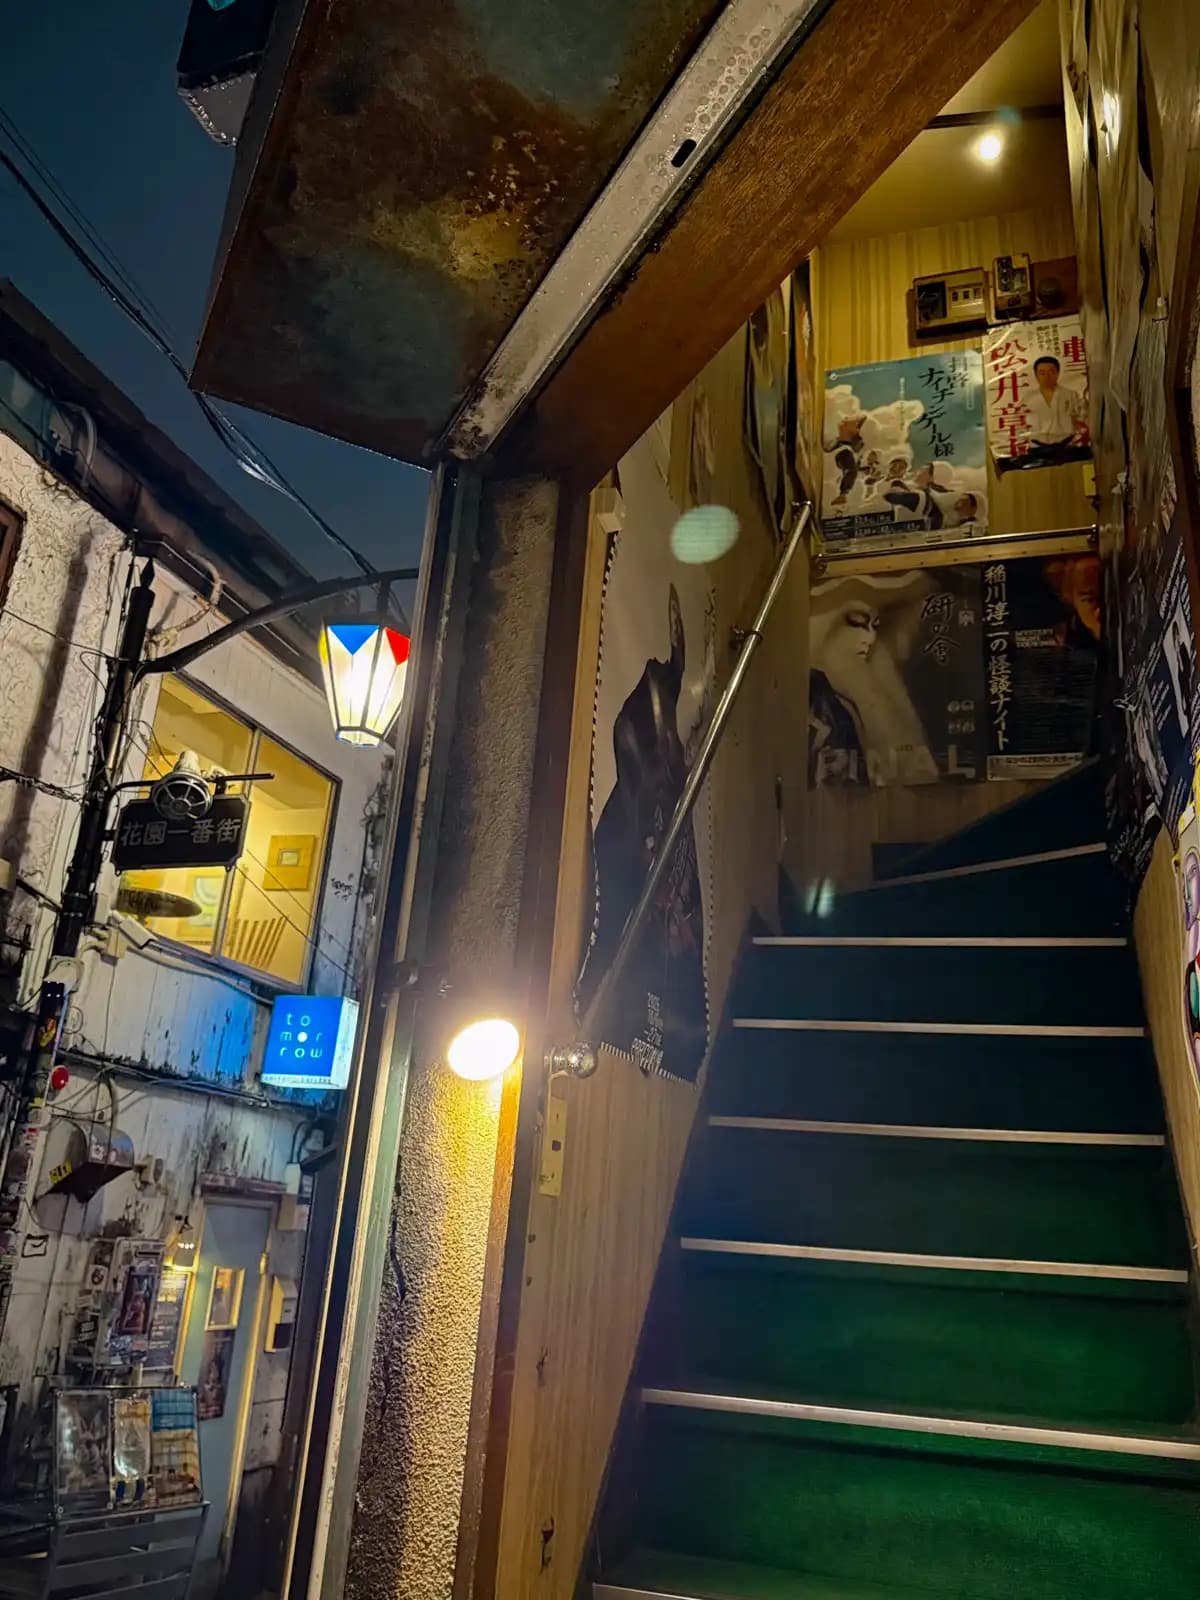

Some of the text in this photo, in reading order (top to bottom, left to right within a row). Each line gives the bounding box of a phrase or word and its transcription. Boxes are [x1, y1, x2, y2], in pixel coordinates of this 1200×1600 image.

[983, 563, 1014, 751] 稲川淳二の怪談ナイト
[286, 1013, 311, 1027] to
[280, 1046, 323, 1058] row
